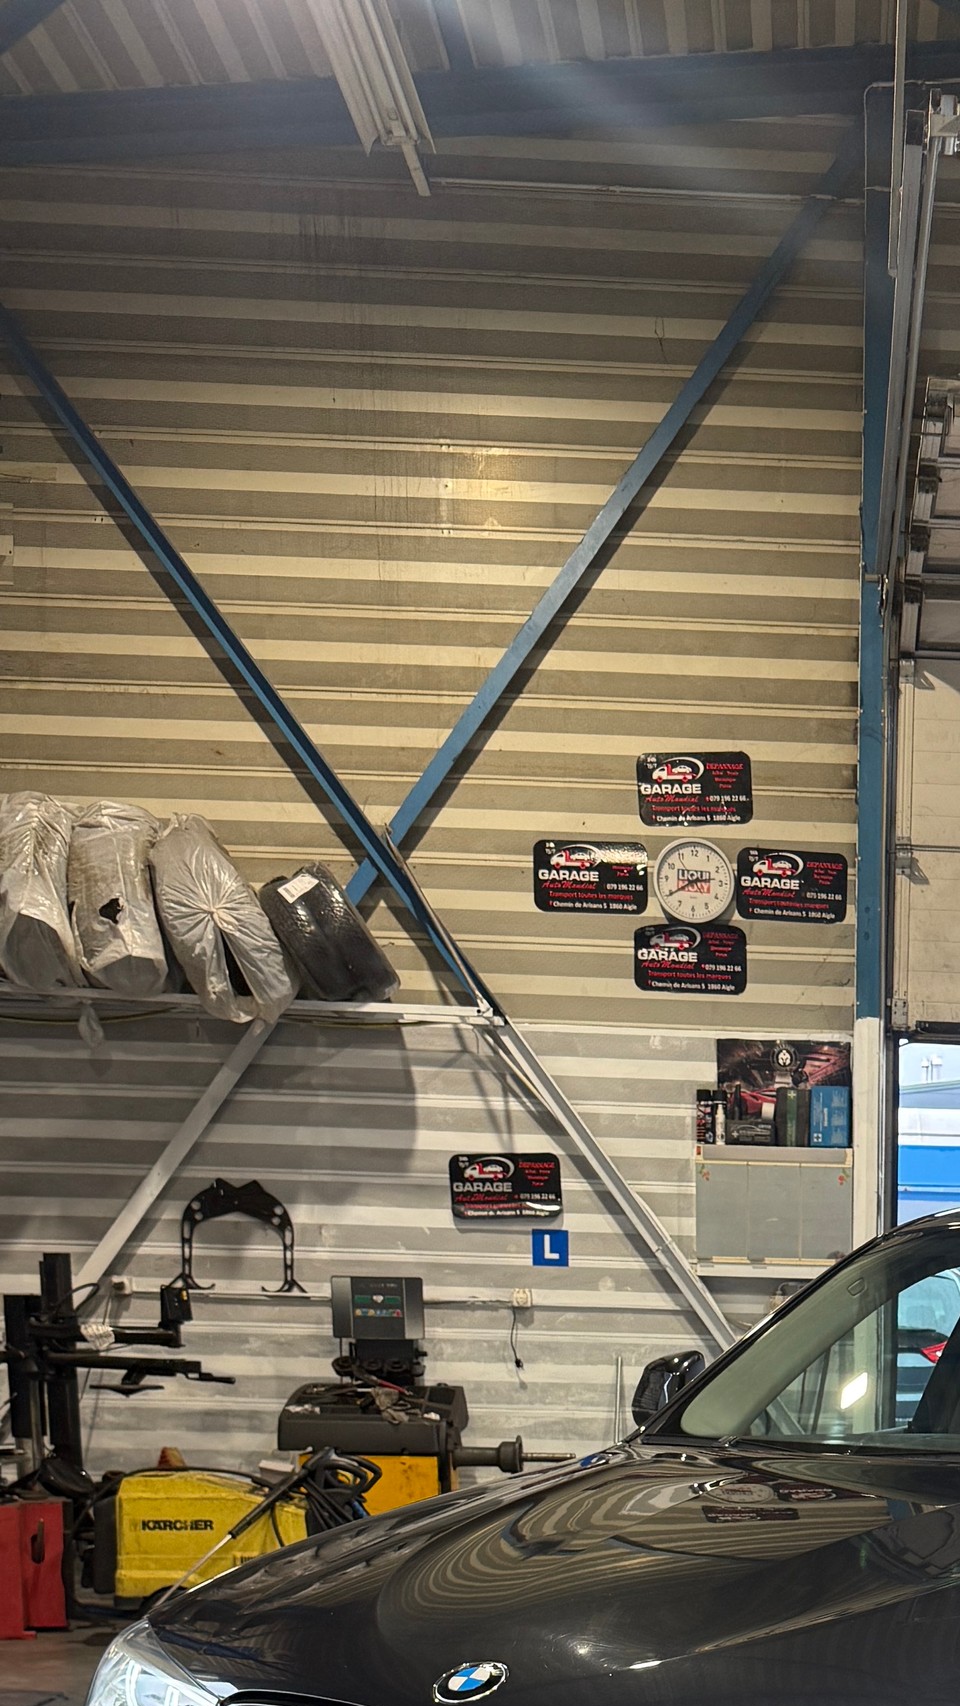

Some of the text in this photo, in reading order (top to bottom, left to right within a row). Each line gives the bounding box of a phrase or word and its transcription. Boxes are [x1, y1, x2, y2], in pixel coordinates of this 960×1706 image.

[641, 783, 702, 794] GARAGE
[668, 862, 720, 874] 10 2
[538, 869, 600, 881] GARAGE
[740, 876, 800, 890] GARAGE
[704, 902, 709, 910] 5
[637, 949, 698, 962] GARAGE
[453, 1182, 513, 1192] GARAGE
[544, 1234, 560, 1260] L
